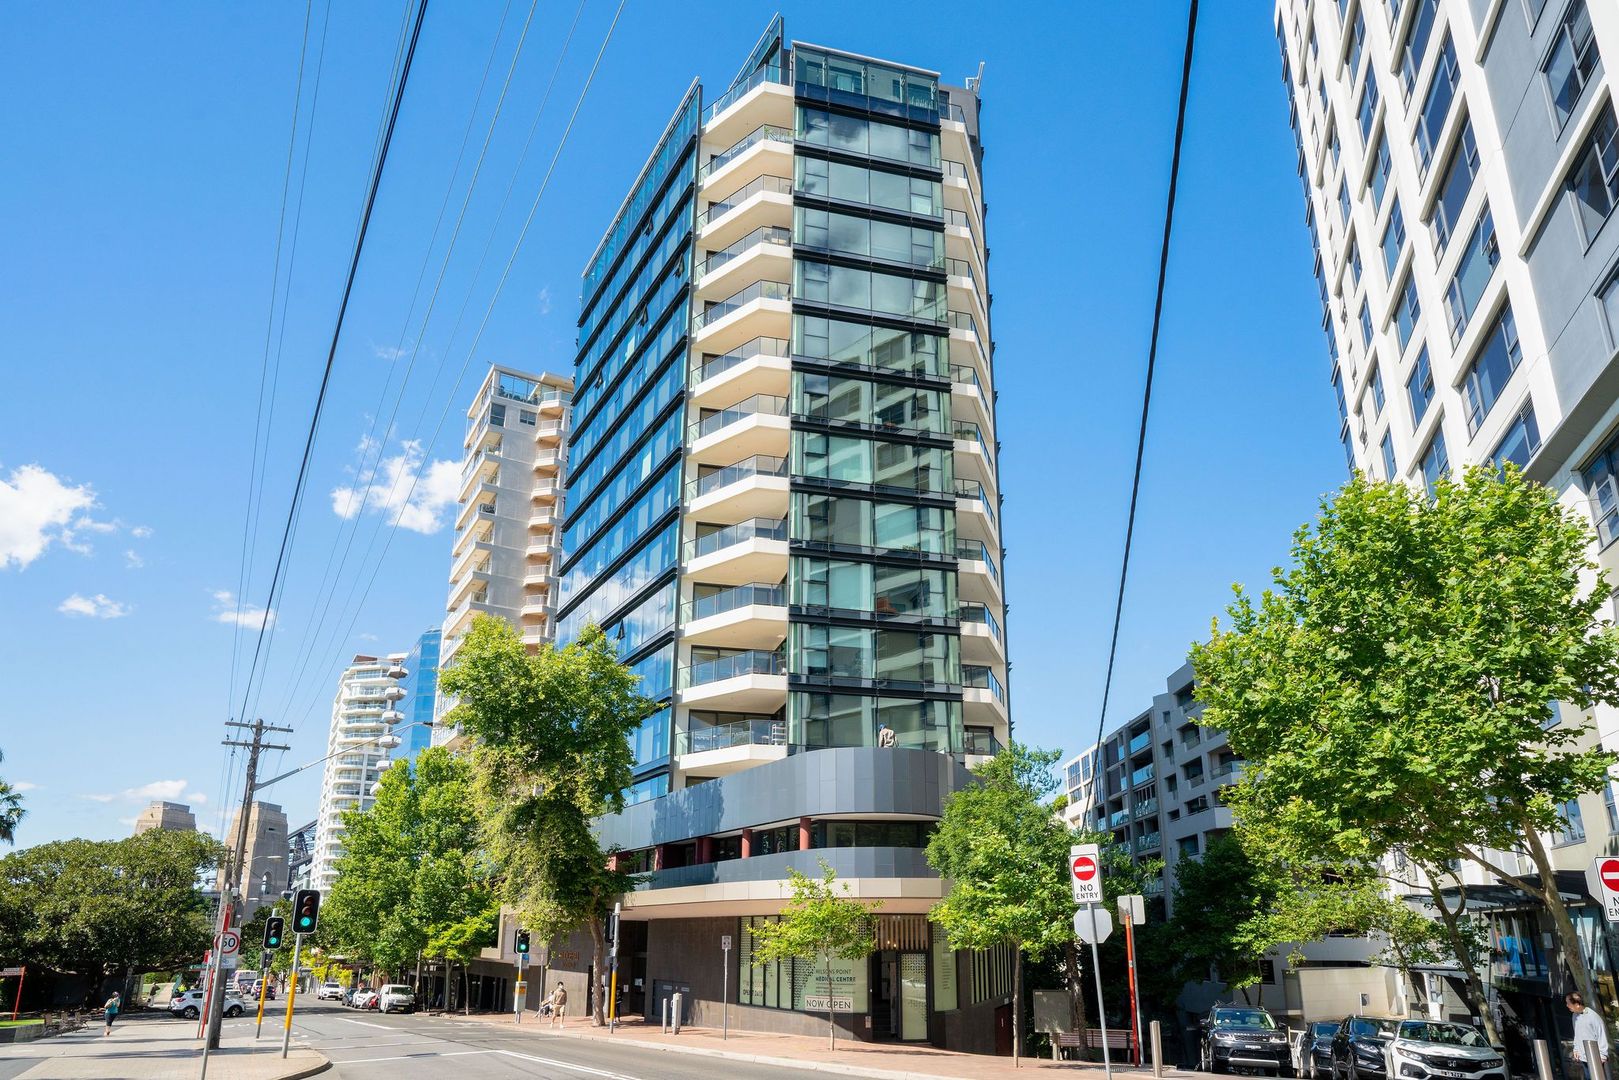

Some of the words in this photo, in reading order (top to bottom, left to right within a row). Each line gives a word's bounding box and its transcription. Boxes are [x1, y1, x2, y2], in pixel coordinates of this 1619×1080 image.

[1080, 884, 1093, 892] NO
[806, 999, 824, 1008] NOW
[826, 1000, 851, 1009] OPEN
